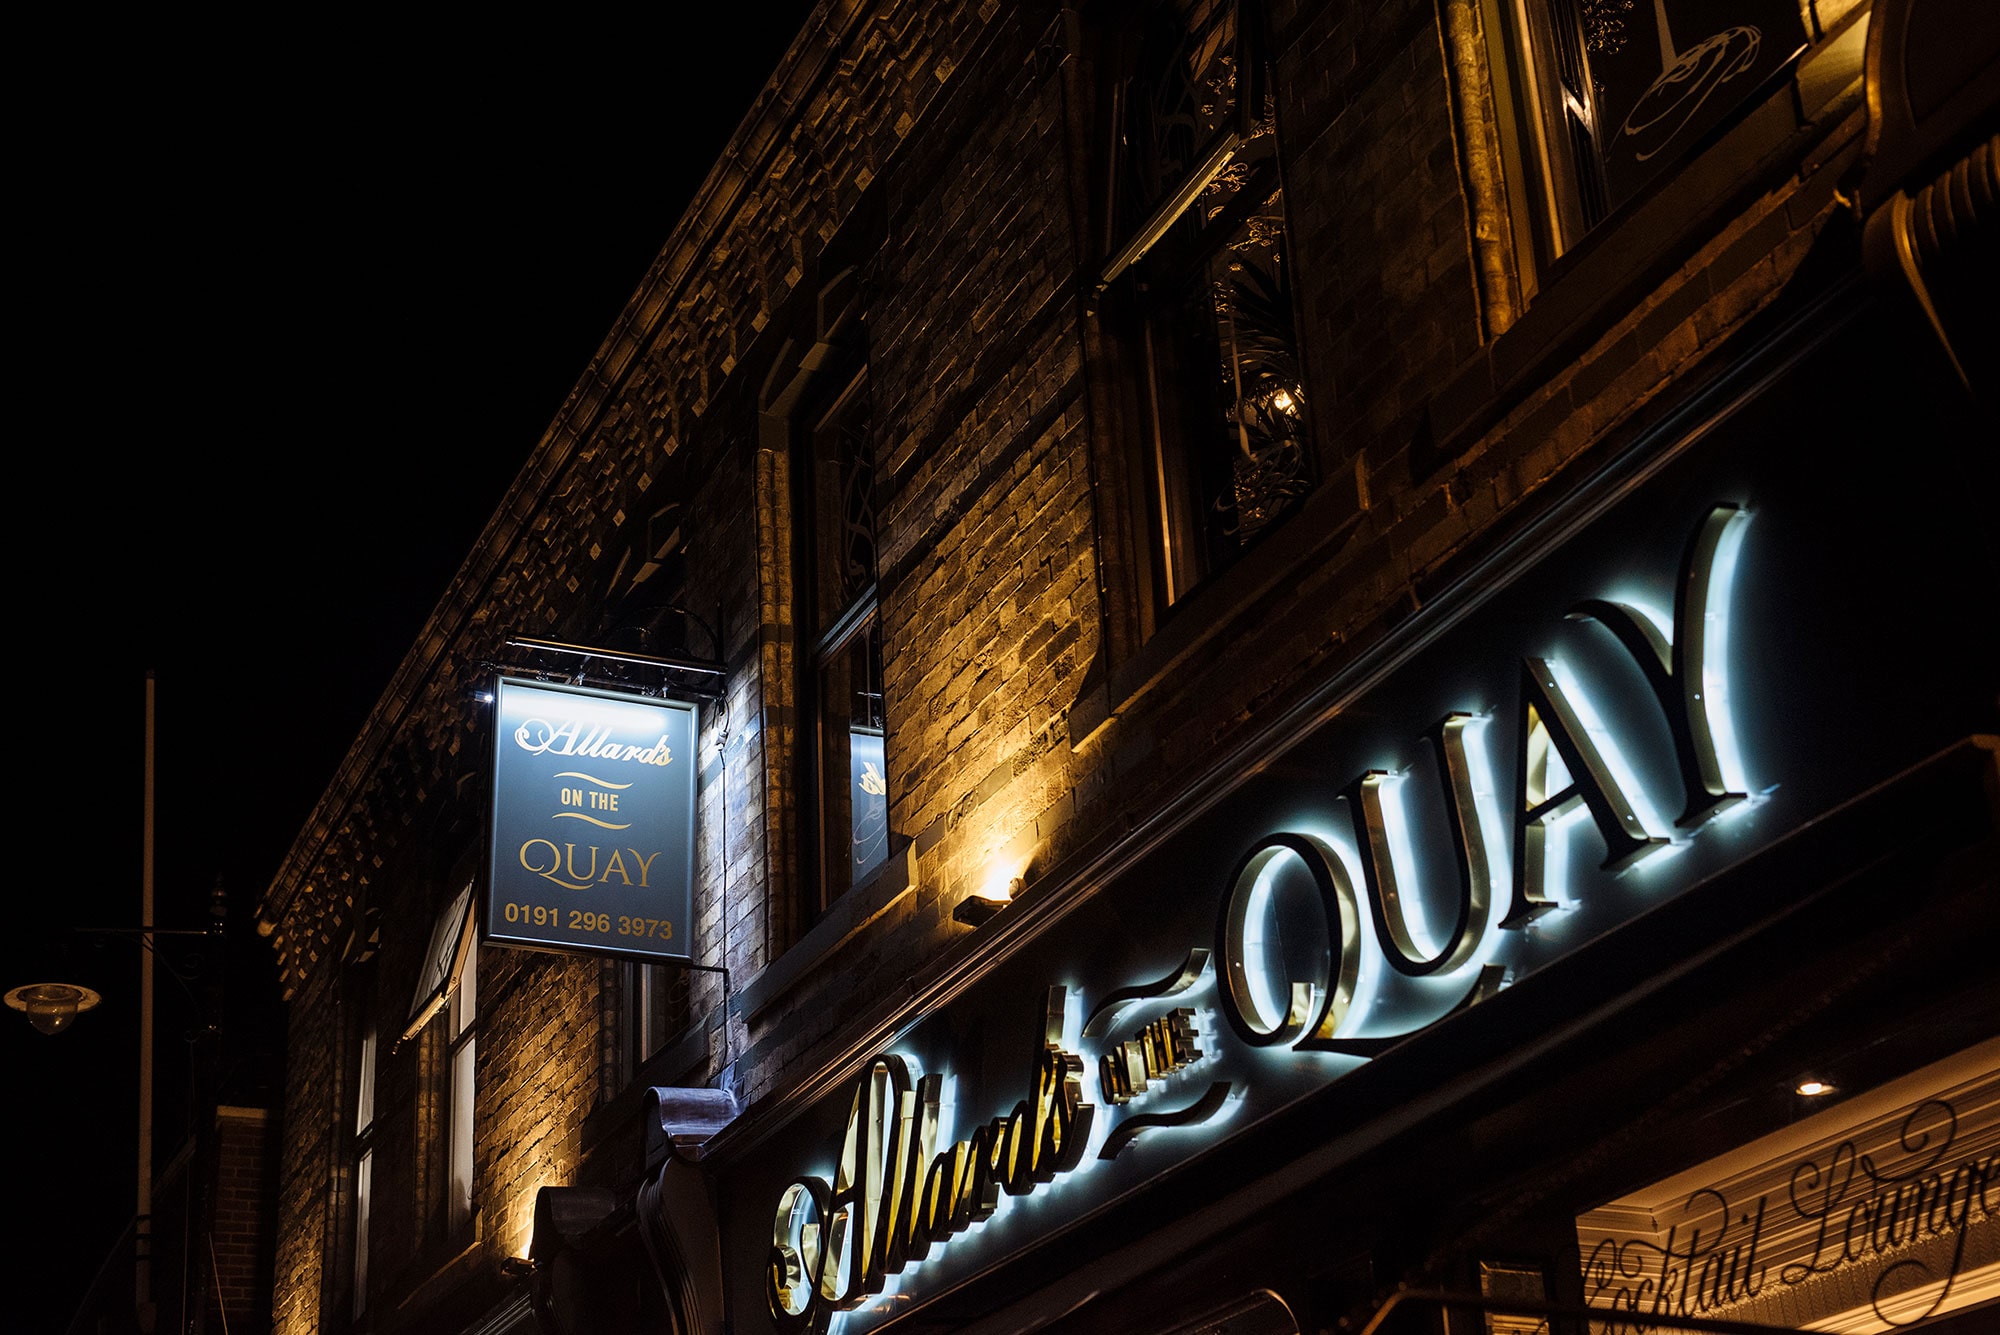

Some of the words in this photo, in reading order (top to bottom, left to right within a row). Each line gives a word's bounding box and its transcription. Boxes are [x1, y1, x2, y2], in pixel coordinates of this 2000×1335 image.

[560, 787, 583, 808] ON
[589, 790, 619, 812] THE
[1214, 502, 1755, 1061] QUAY
[519, 838, 662, 890] QUAY
[504, 902, 559, 928] 0191
[568, 909, 611, 934] 296
[617, 915, 673, 940] 3973
